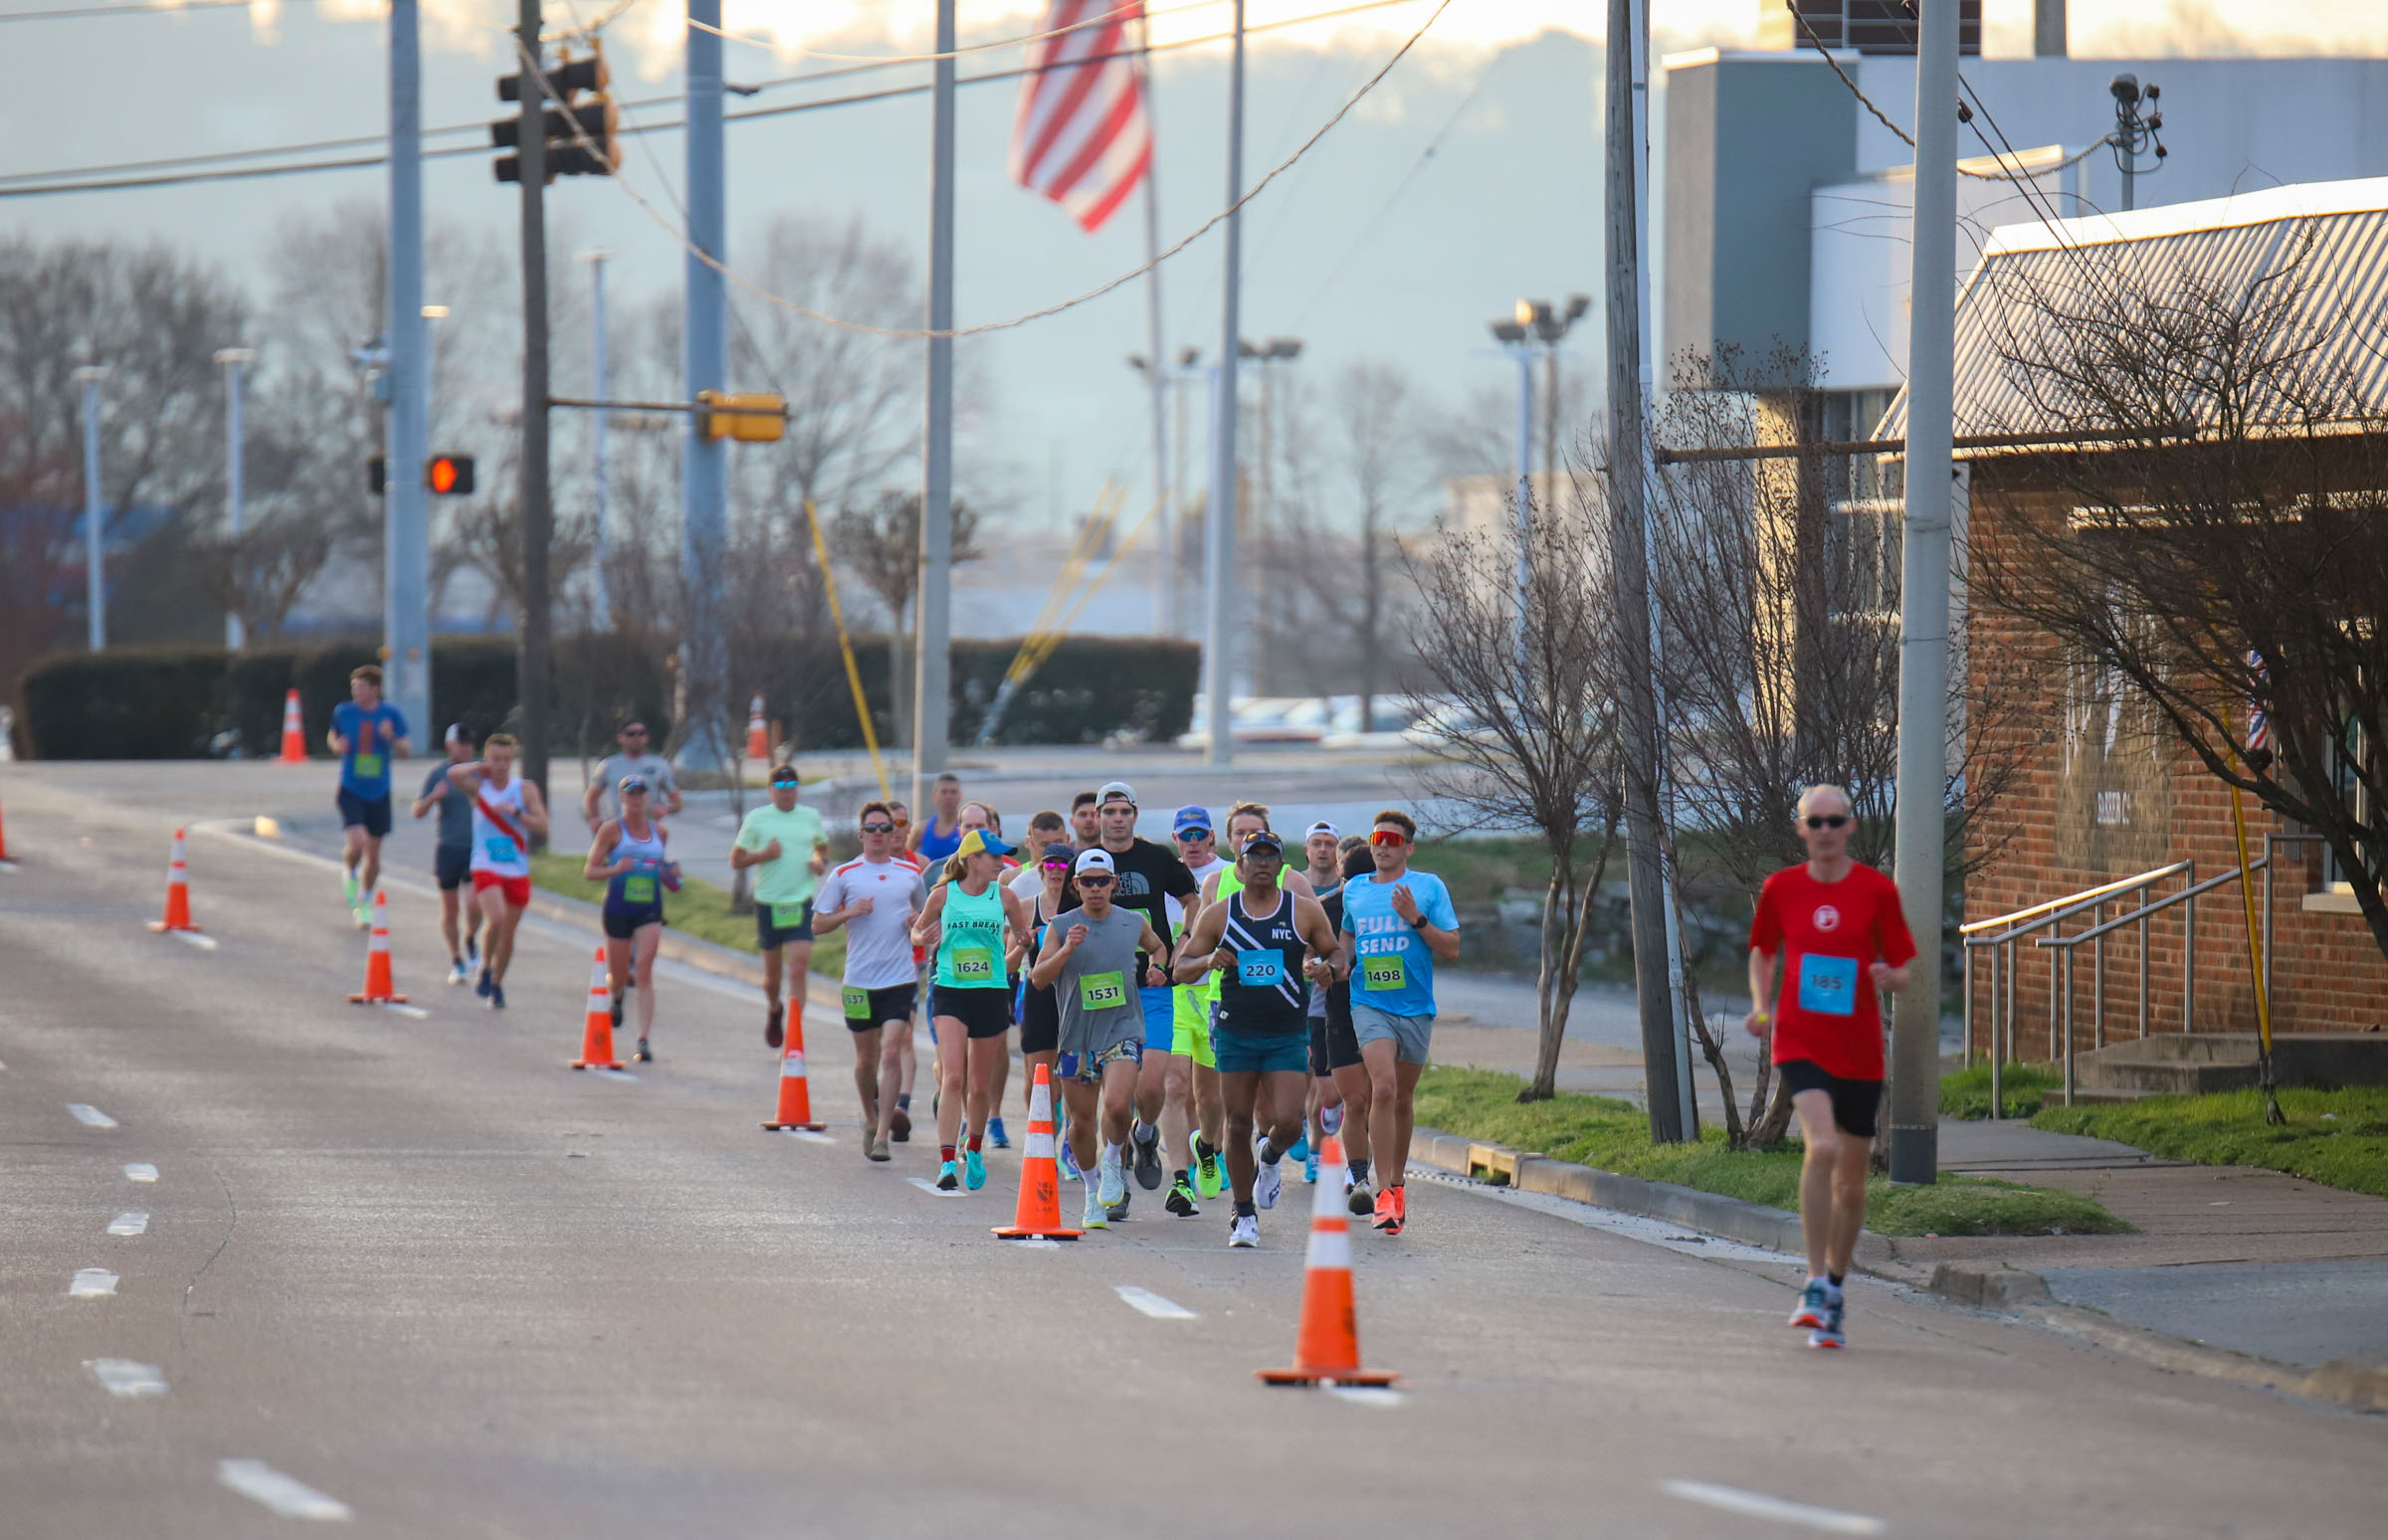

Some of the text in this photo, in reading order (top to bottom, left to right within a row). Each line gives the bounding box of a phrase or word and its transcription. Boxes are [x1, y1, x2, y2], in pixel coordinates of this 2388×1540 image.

[972, 921, 1000, 930] BREAK
[1357, 915, 1409, 933] FULL
[1272, 928, 1292, 940] NYC
[1360, 936, 1410, 954] SEND
[957, 961, 989, 973] 1624
[1246, 965, 1276, 977] 220
[1367, 969, 1401, 982] 1498
[1088, 986, 1118, 1001] 1531
